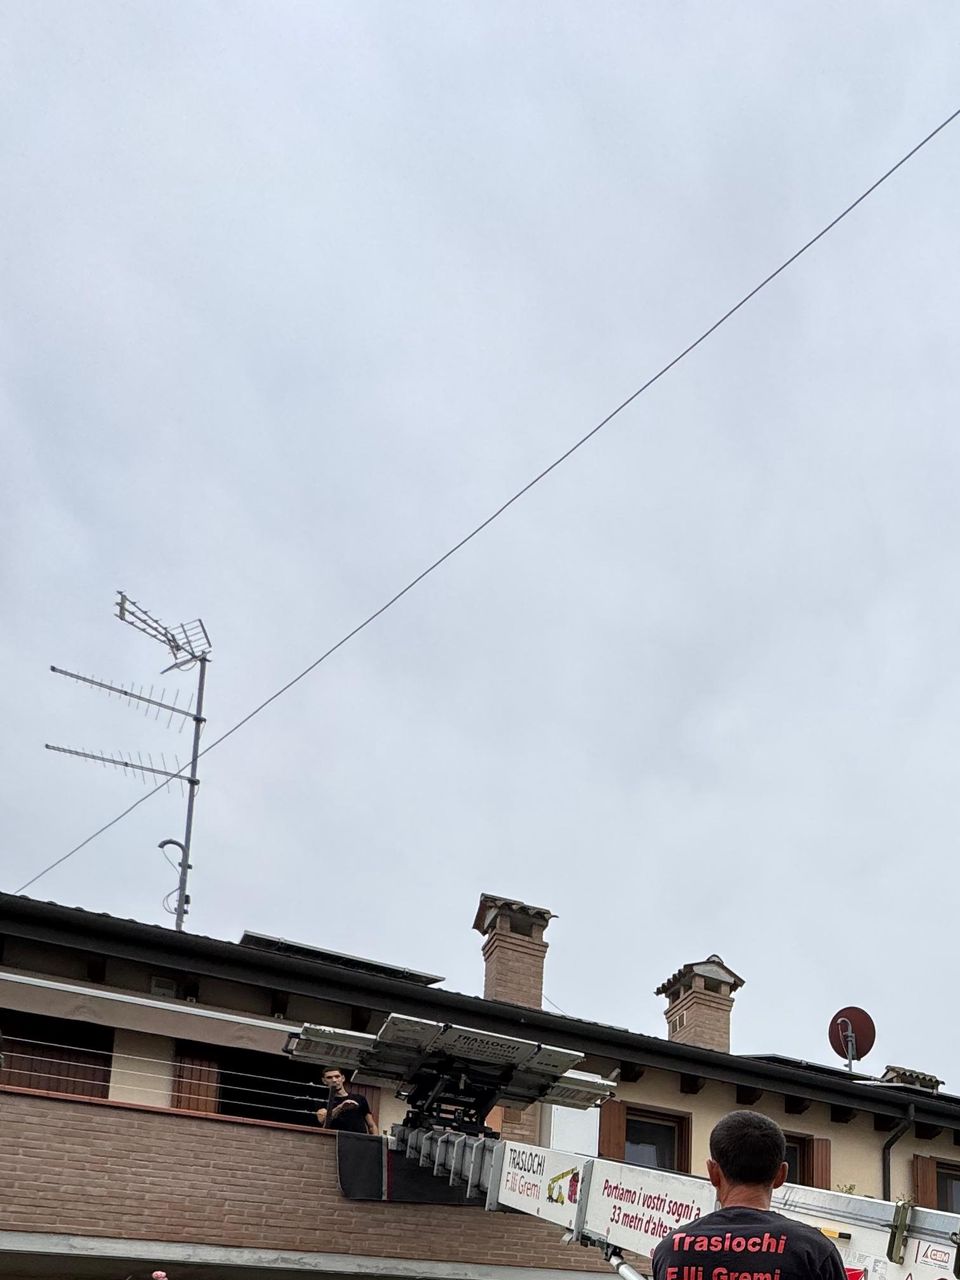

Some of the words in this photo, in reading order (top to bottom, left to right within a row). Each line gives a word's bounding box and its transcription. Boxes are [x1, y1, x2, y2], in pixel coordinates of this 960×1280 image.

[509, 1148, 546, 1176] TRASLOCHI
[518, 1176, 543, 1201] Gremi
[602, 1178, 636, 1205] Portiamo
[642, 1193, 668, 1213] vostri
[666, 1199, 695, 1223] sogni
[694, 1206, 701, 1219] a
[610, 1204, 621, 1225] 33
[623, 1212, 645, 1233] metri
[672, 1232, 787, 1254] Traslochi
